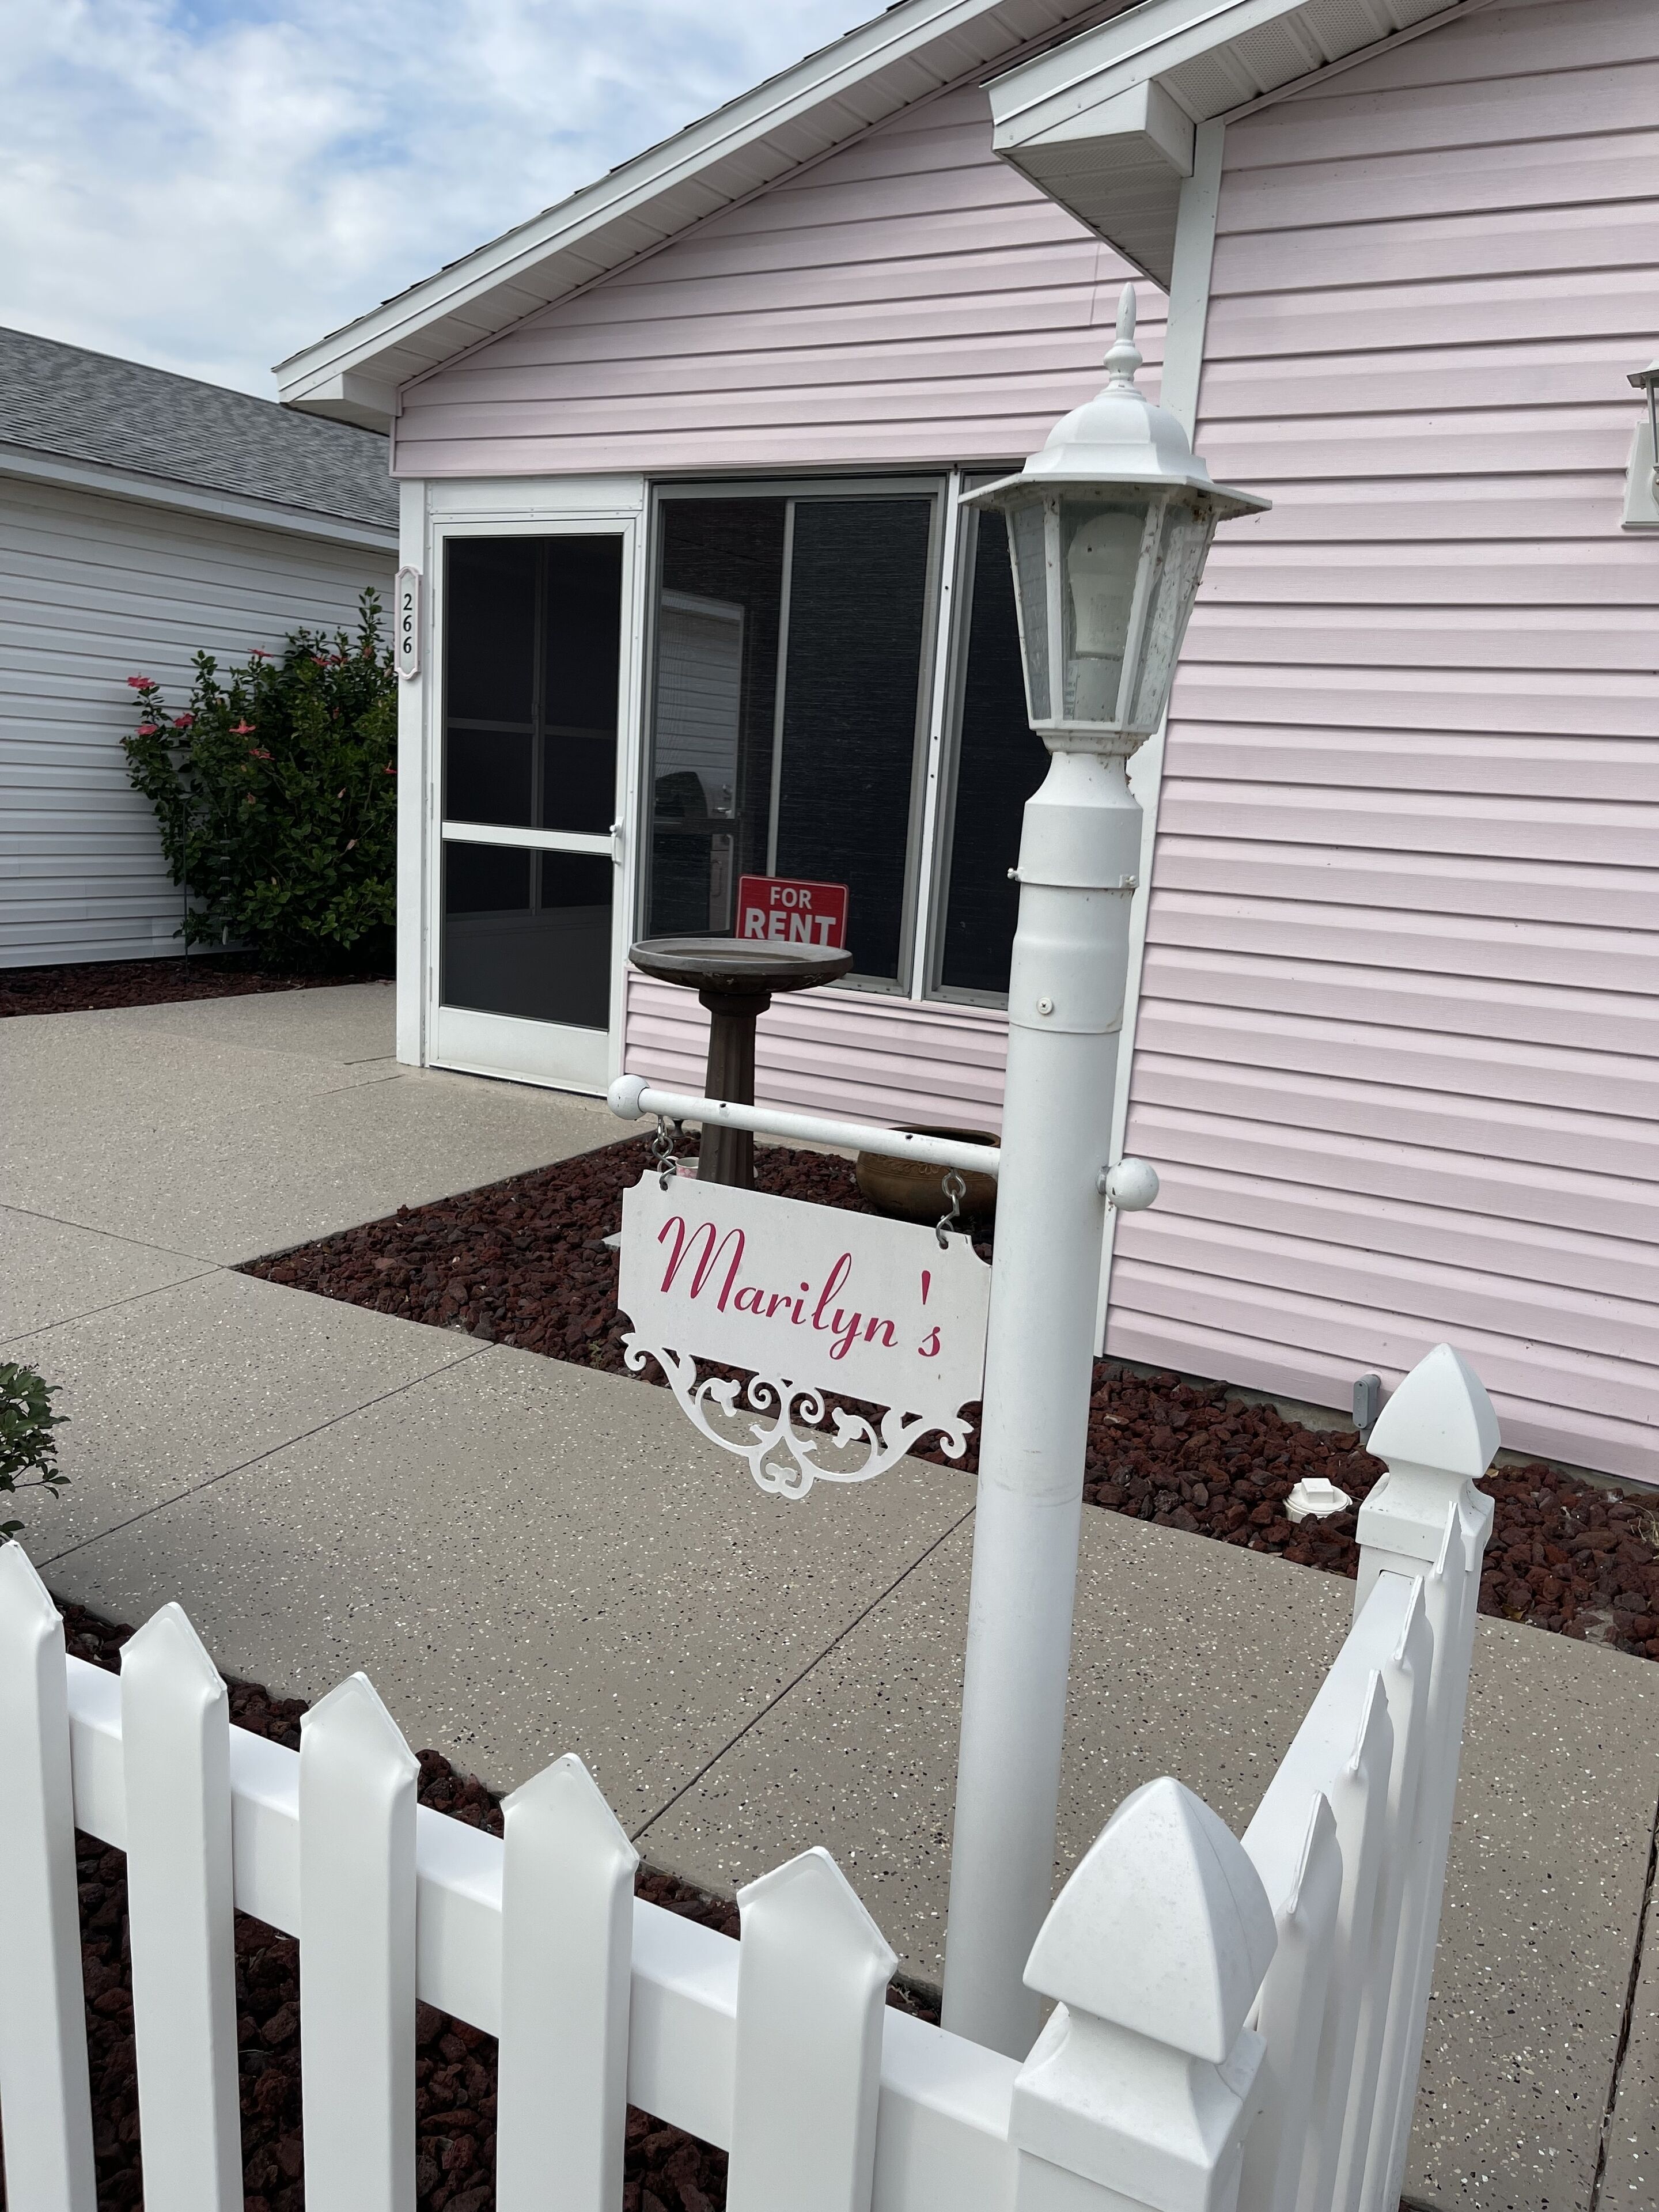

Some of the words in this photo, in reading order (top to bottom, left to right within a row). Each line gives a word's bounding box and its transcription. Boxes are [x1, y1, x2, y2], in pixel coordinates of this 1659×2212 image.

[403, 593, 413, 654] 266
[770, 886, 812, 910] FOR
[744, 907, 837, 946] RENT
[657, 1215, 942, 1361] Marilyn's
